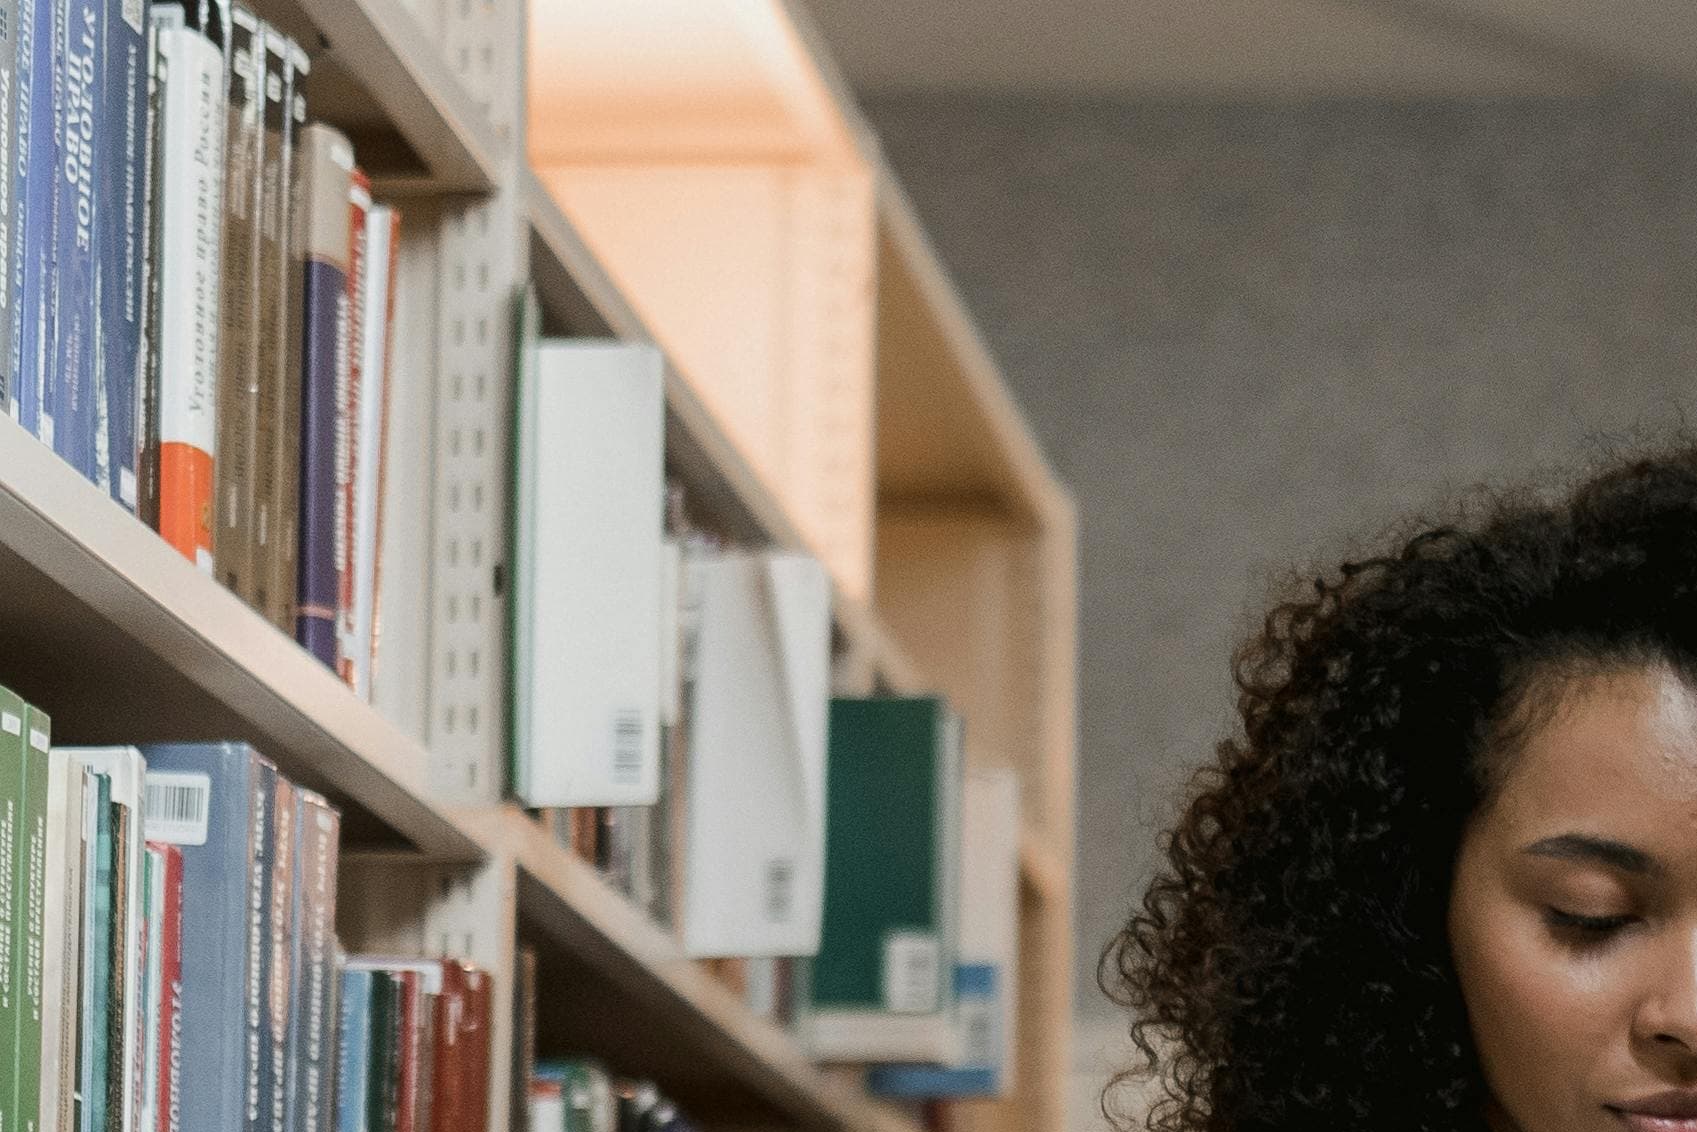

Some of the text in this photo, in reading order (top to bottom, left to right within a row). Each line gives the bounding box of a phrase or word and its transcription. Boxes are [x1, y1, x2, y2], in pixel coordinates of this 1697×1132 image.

[1, 69, 9, 215] Уголовное
[18, 81, 29, 177] ПРАВО
[65, 52, 81, 184] ПРАВО
[76, 6, 95, 252] УГОЛОВНОЕ
[189, 72, 210, 416] Уголовное право России
[34, 816, 43, 936] ПРЕСТУПЛЕНИЯ
